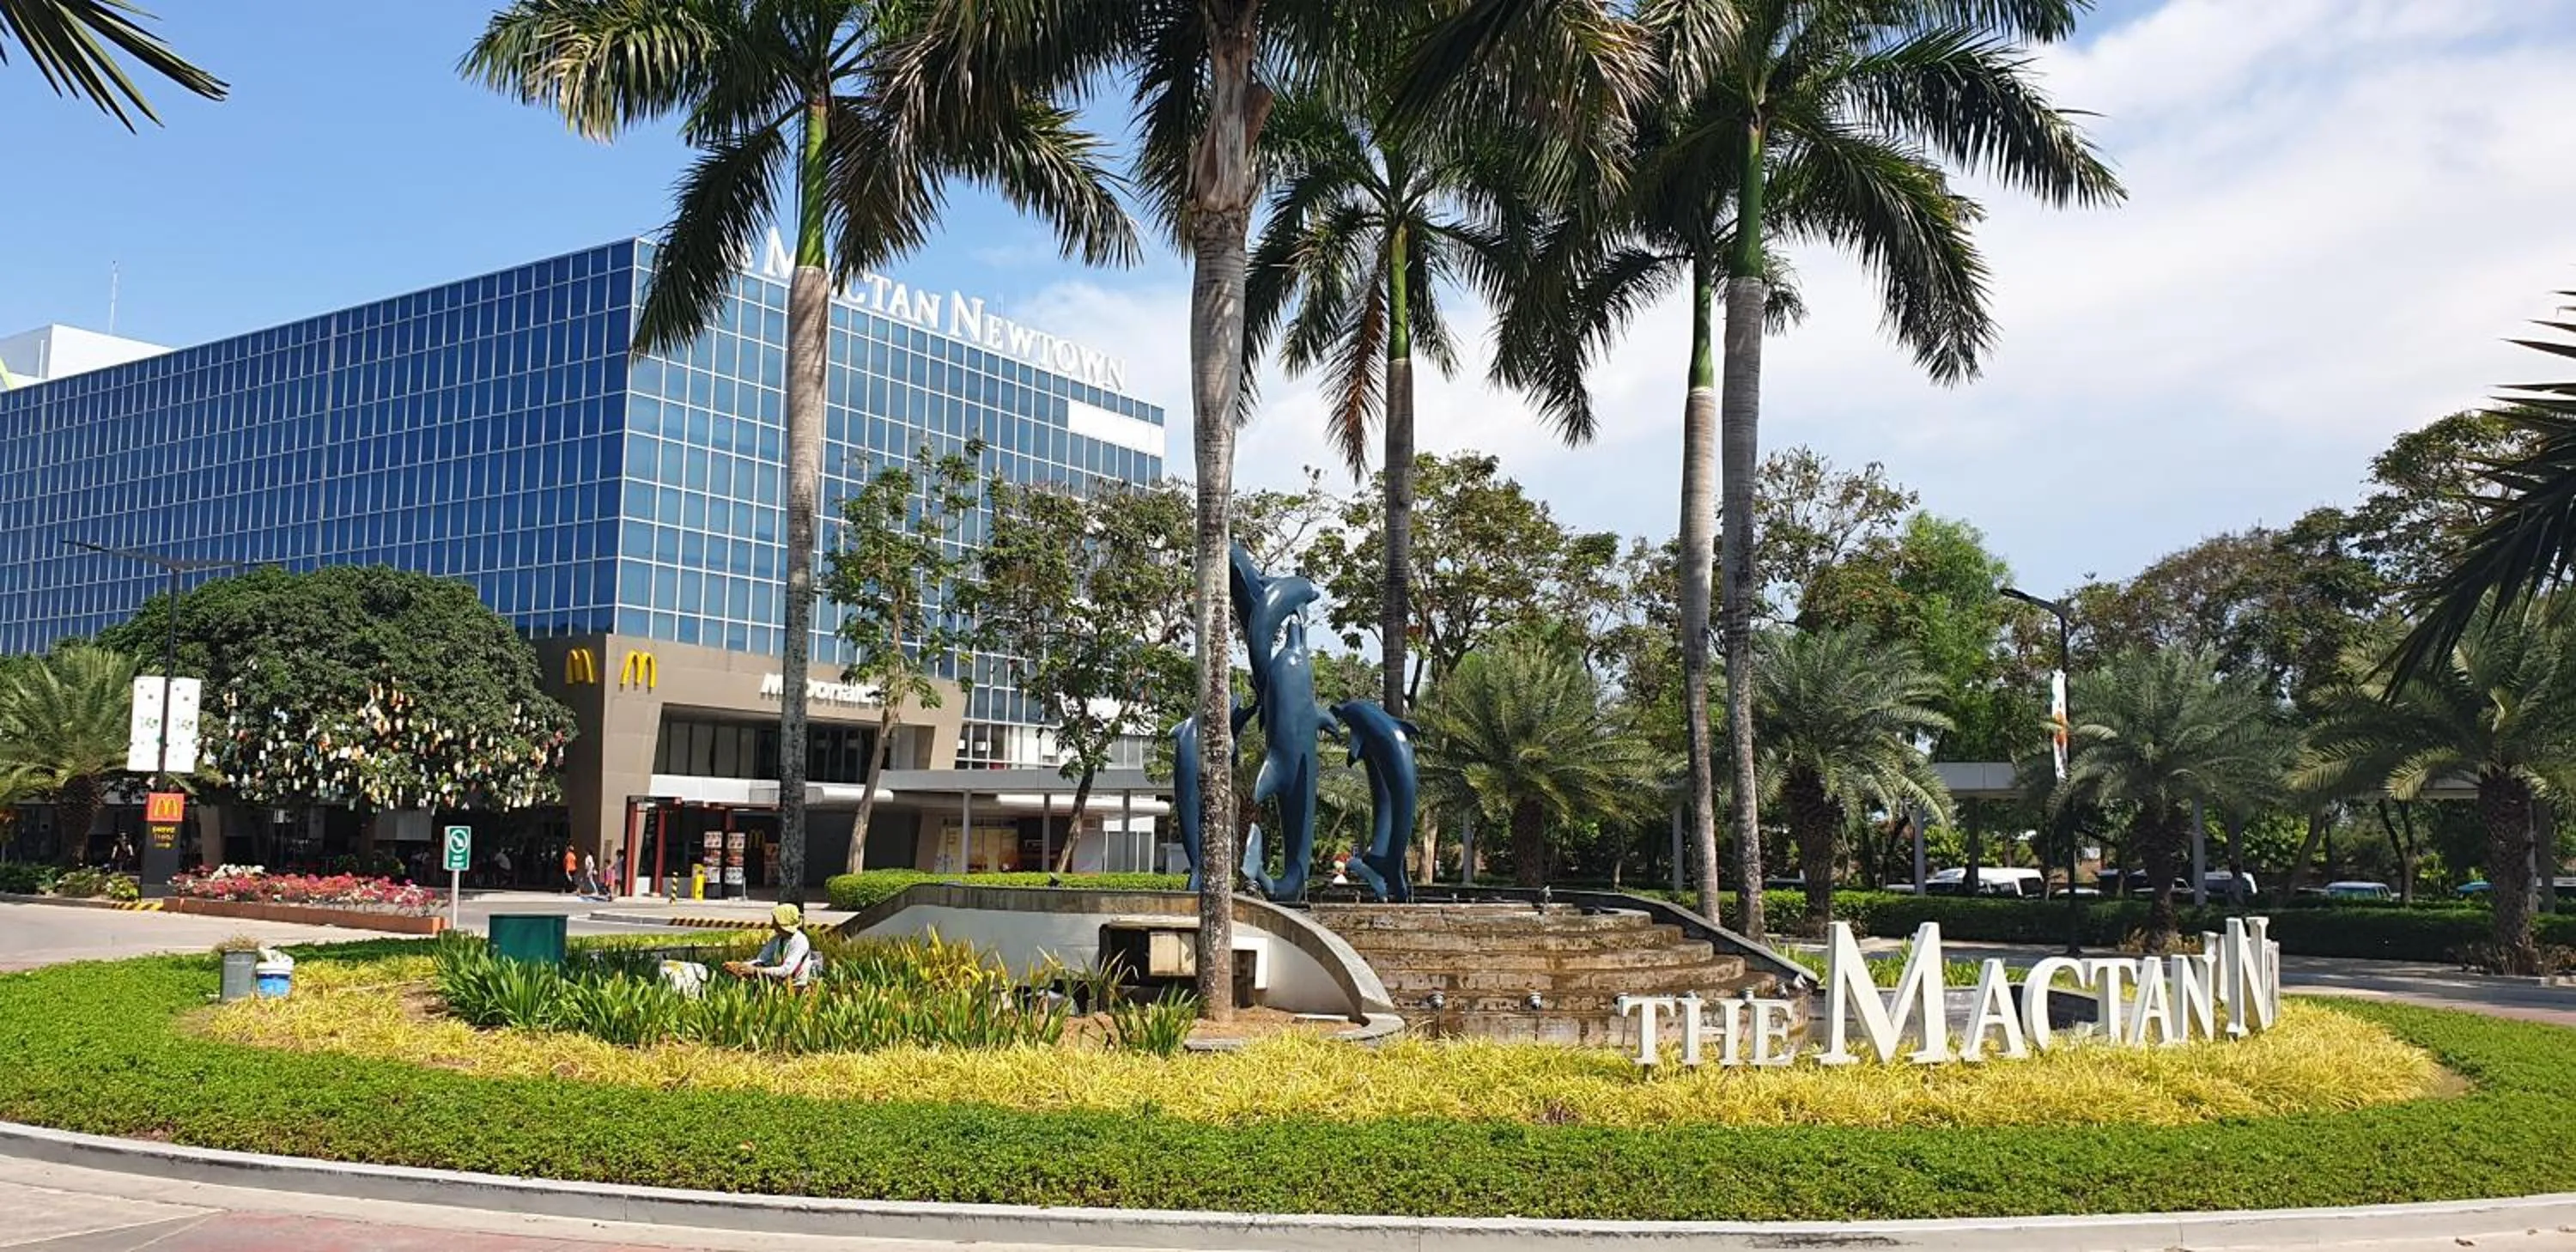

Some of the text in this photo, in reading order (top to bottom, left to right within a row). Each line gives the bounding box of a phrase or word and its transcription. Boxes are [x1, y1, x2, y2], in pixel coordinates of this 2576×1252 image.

[948, 290, 1127, 391] NEWTOWN
[1615, 993, 1796, 1066] THE
[1814, 921, 2217, 1065] MACTAN
